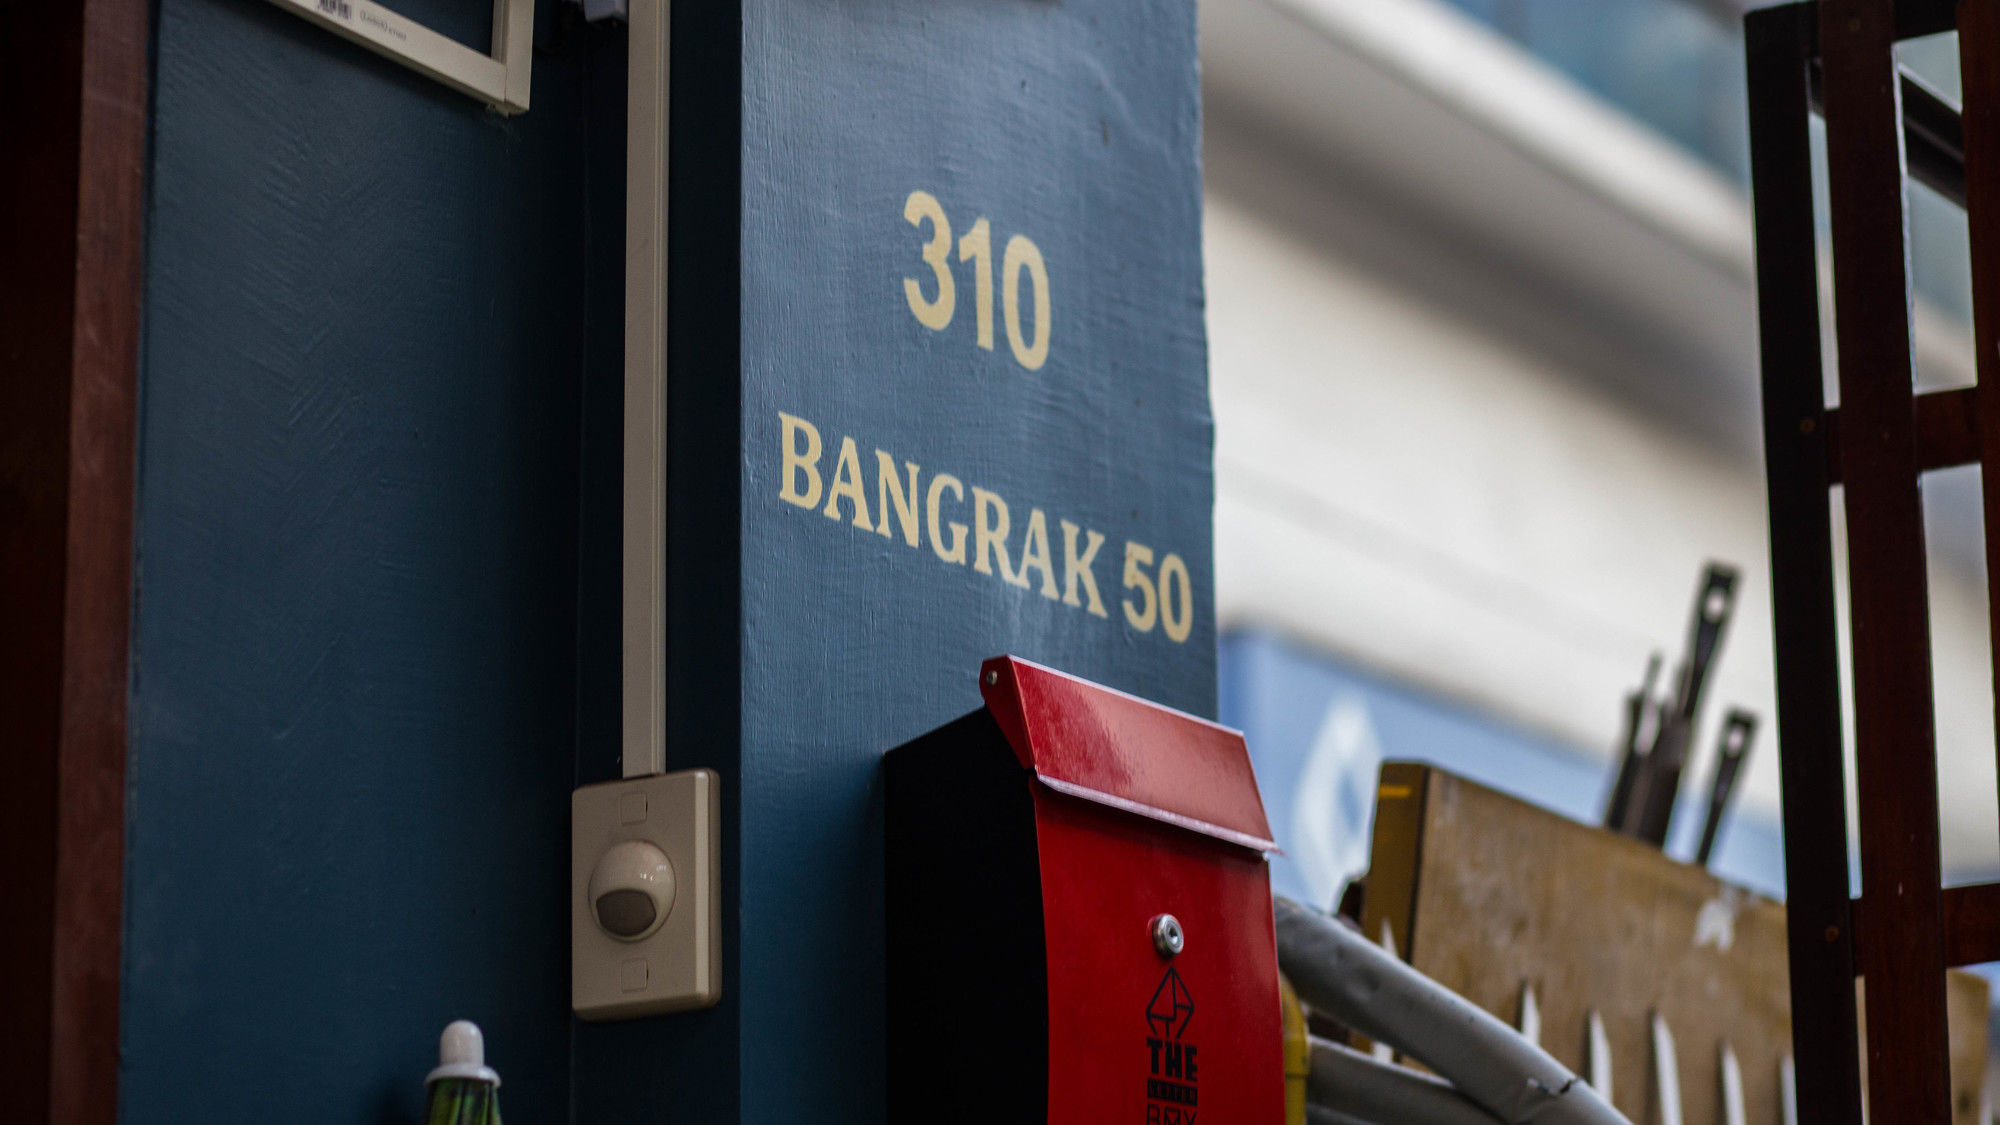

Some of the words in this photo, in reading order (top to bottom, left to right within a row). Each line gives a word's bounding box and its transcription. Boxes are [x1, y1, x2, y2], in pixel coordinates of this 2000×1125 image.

[904, 190, 1051, 370] 310
[778, 411, 1108, 618] BANGRAK
[1122, 541, 1194, 643] 50
[1147, 1036, 1198, 1081] THE
